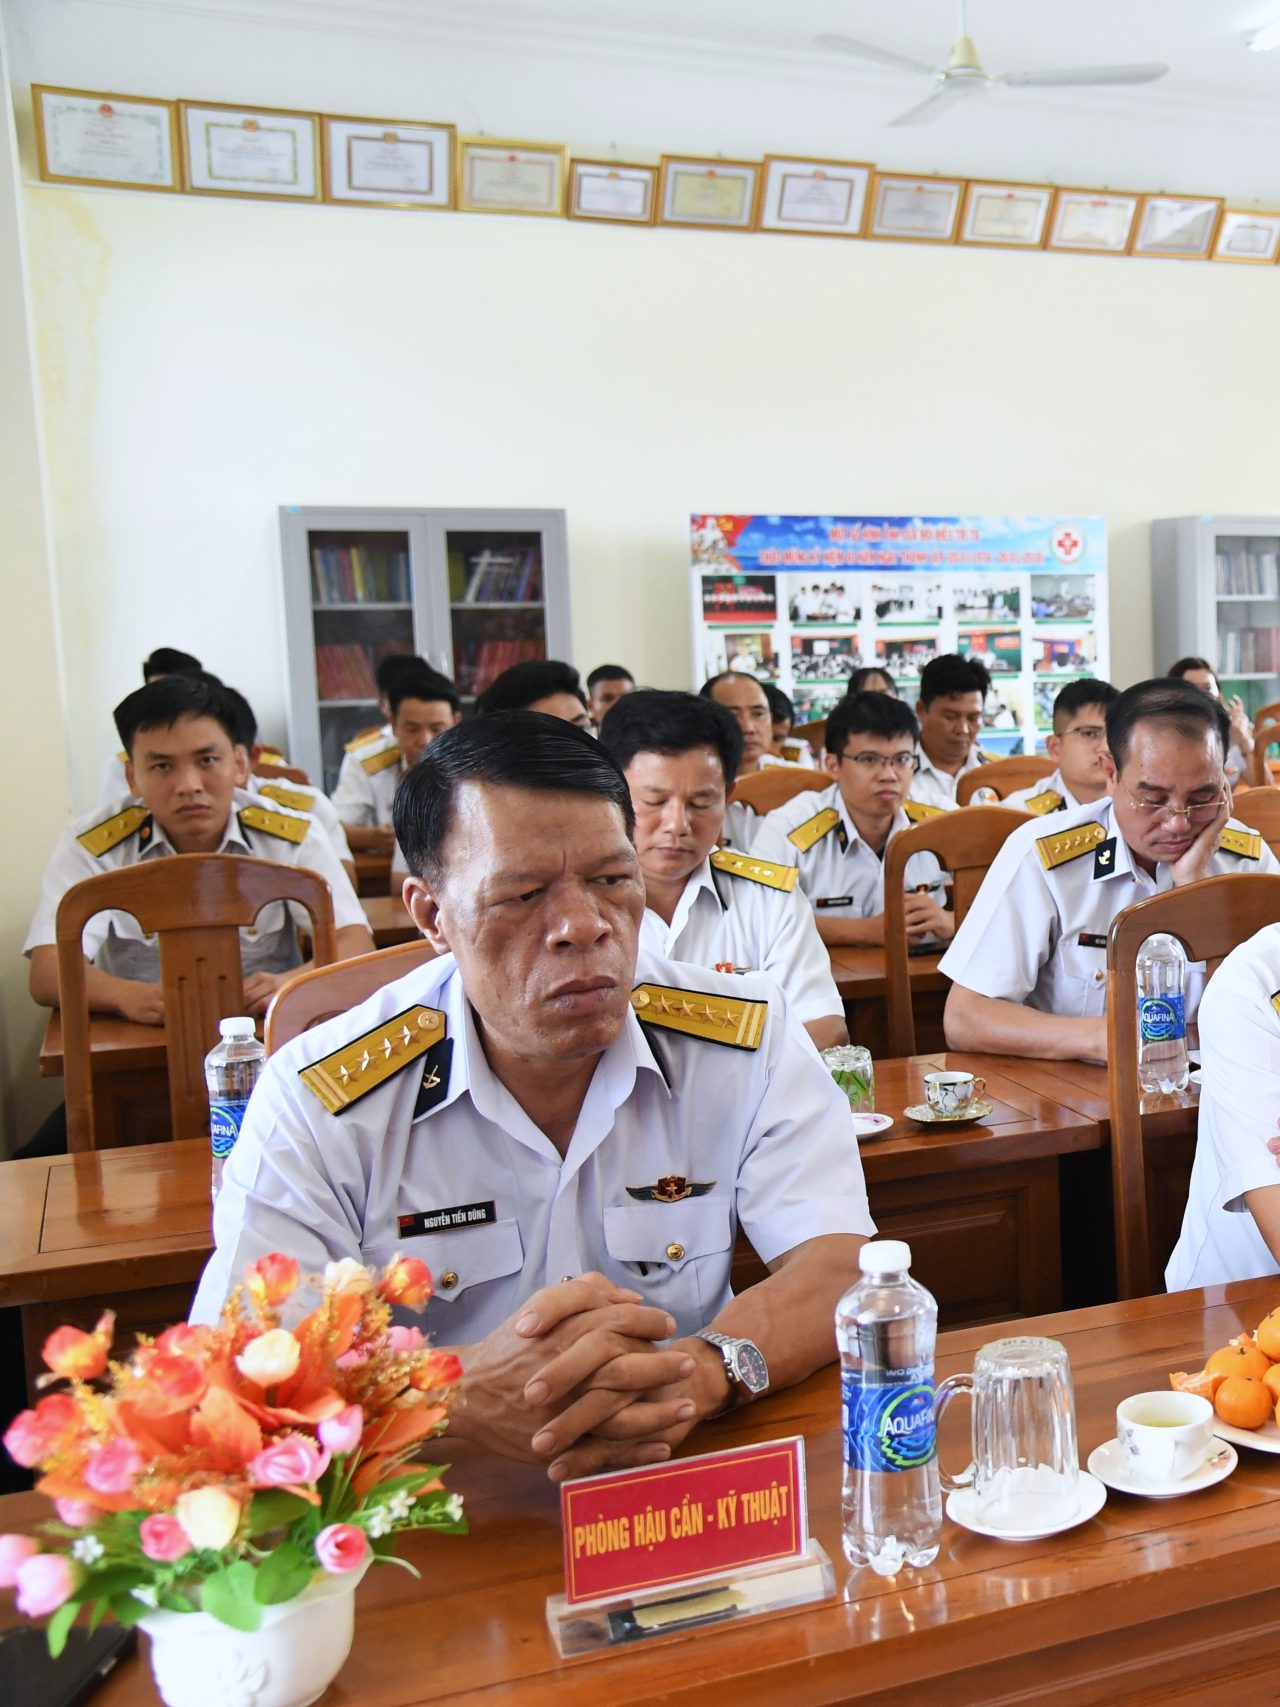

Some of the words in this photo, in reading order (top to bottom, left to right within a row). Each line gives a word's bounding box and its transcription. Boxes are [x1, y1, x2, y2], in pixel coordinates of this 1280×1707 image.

[423, 1211, 451, 1229] NGUYỄN
[451, 1208, 467, 1225] TIẾN
[467, 1207, 487, 1222] DŨNG
[574, 1513, 631, 1559] PHÒNG
[633, 1504, 667, 1551] HẬU
[717, 1488, 738, 1530] KỸ
[740, 1480, 789, 1526] THUẬT
